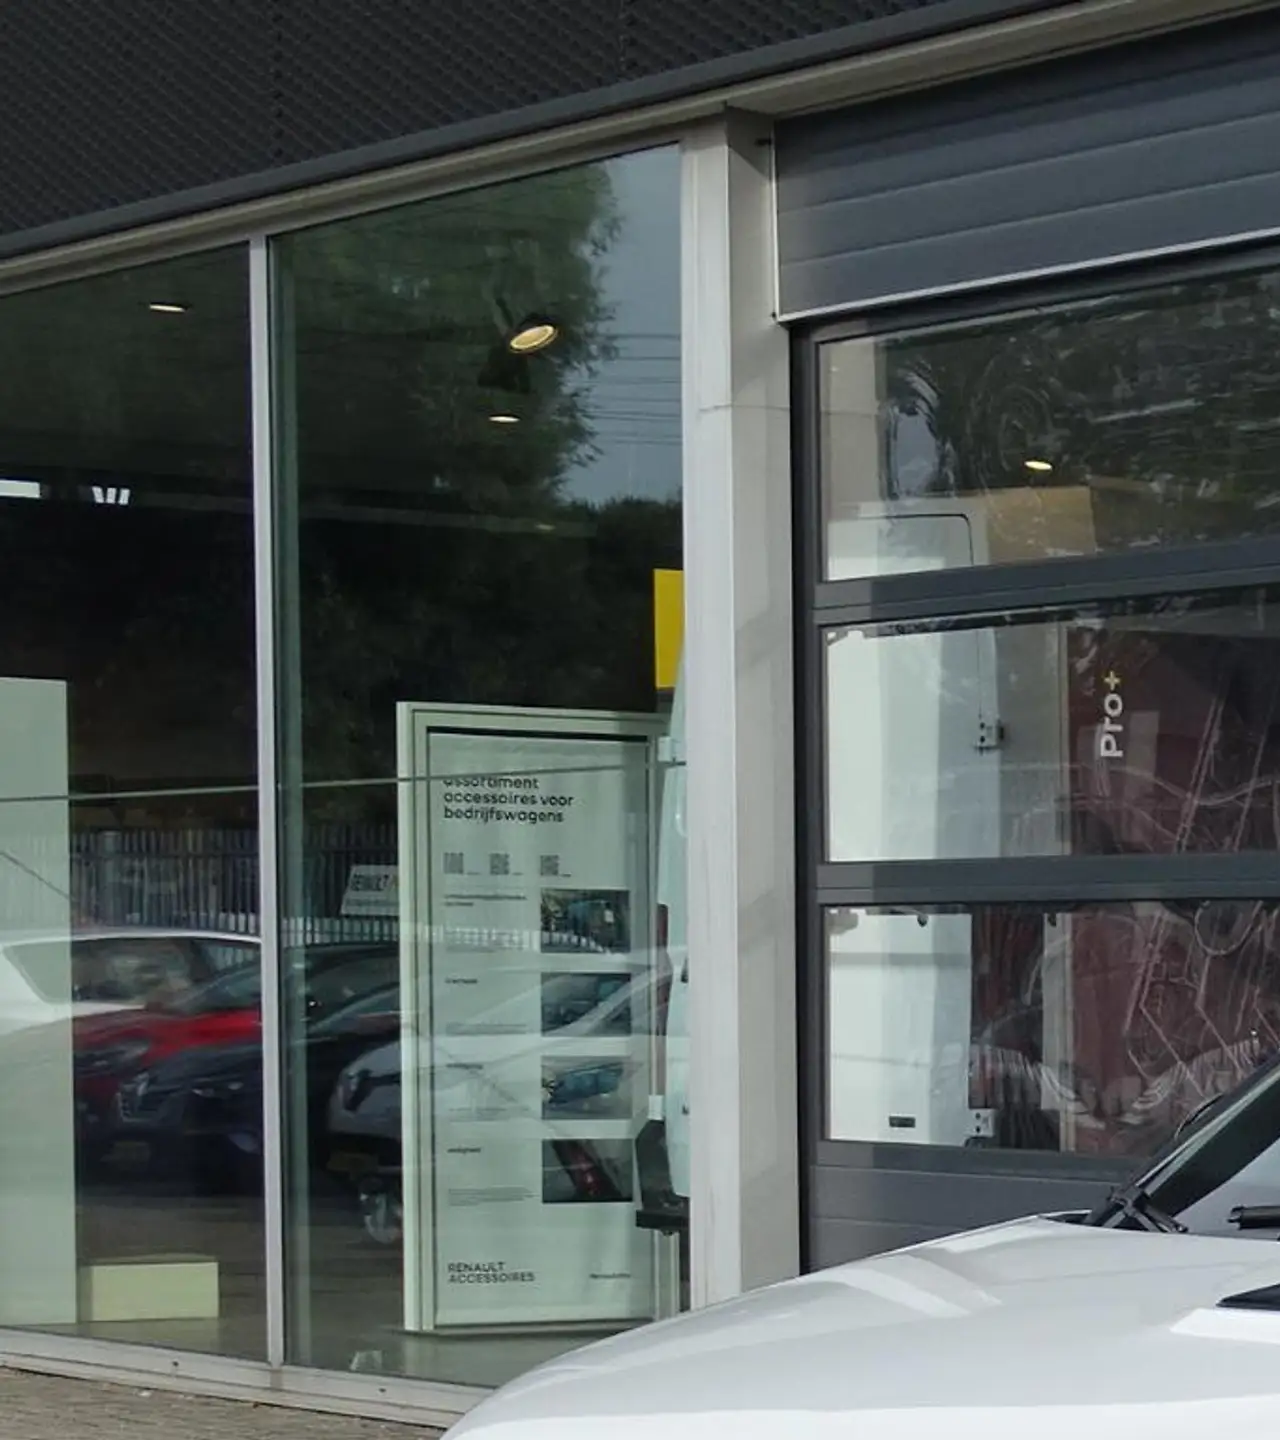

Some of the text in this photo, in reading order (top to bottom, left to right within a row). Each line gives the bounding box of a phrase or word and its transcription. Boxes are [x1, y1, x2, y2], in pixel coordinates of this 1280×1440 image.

[443, 791, 575, 807] accessoires voor
[443, 805, 565, 825] bedrijfswagens
